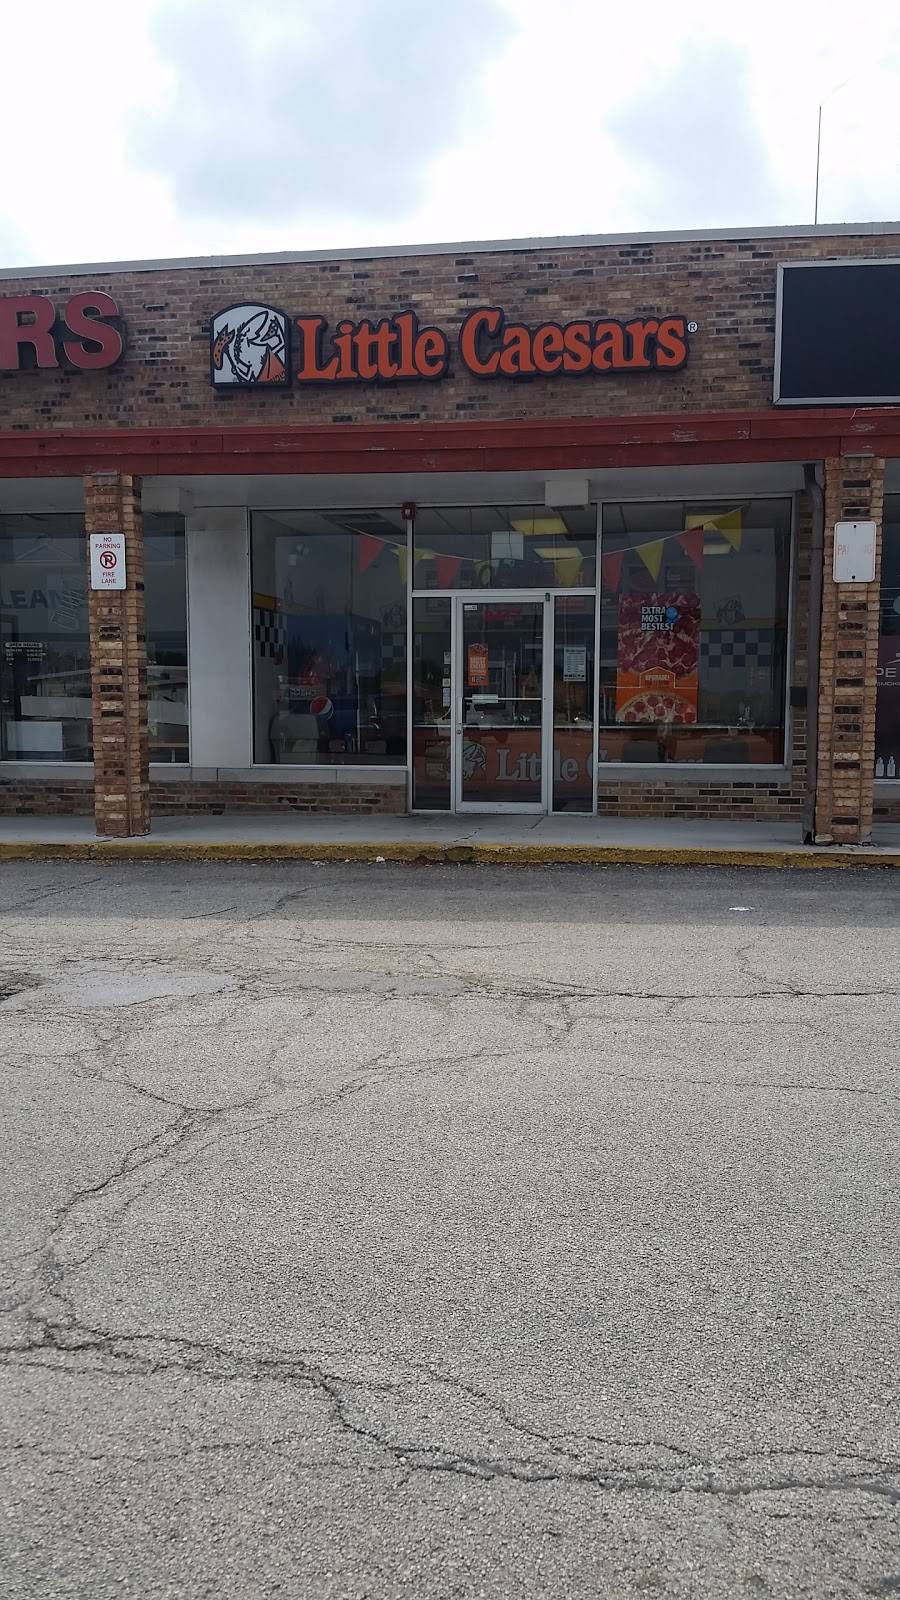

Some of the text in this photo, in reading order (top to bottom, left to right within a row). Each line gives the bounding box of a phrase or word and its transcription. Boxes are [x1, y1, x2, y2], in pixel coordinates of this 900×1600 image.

[0, 291, 122, 369] RS
[296, 313, 446, 380] Little
[461, 310, 688, 375] Caesars
[641, 606, 666, 615] EXTRA
[641, 614, 664, 623] MOST
[641, 622, 675, 631] BESTEST
[495, 748, 579, 782] Litle
